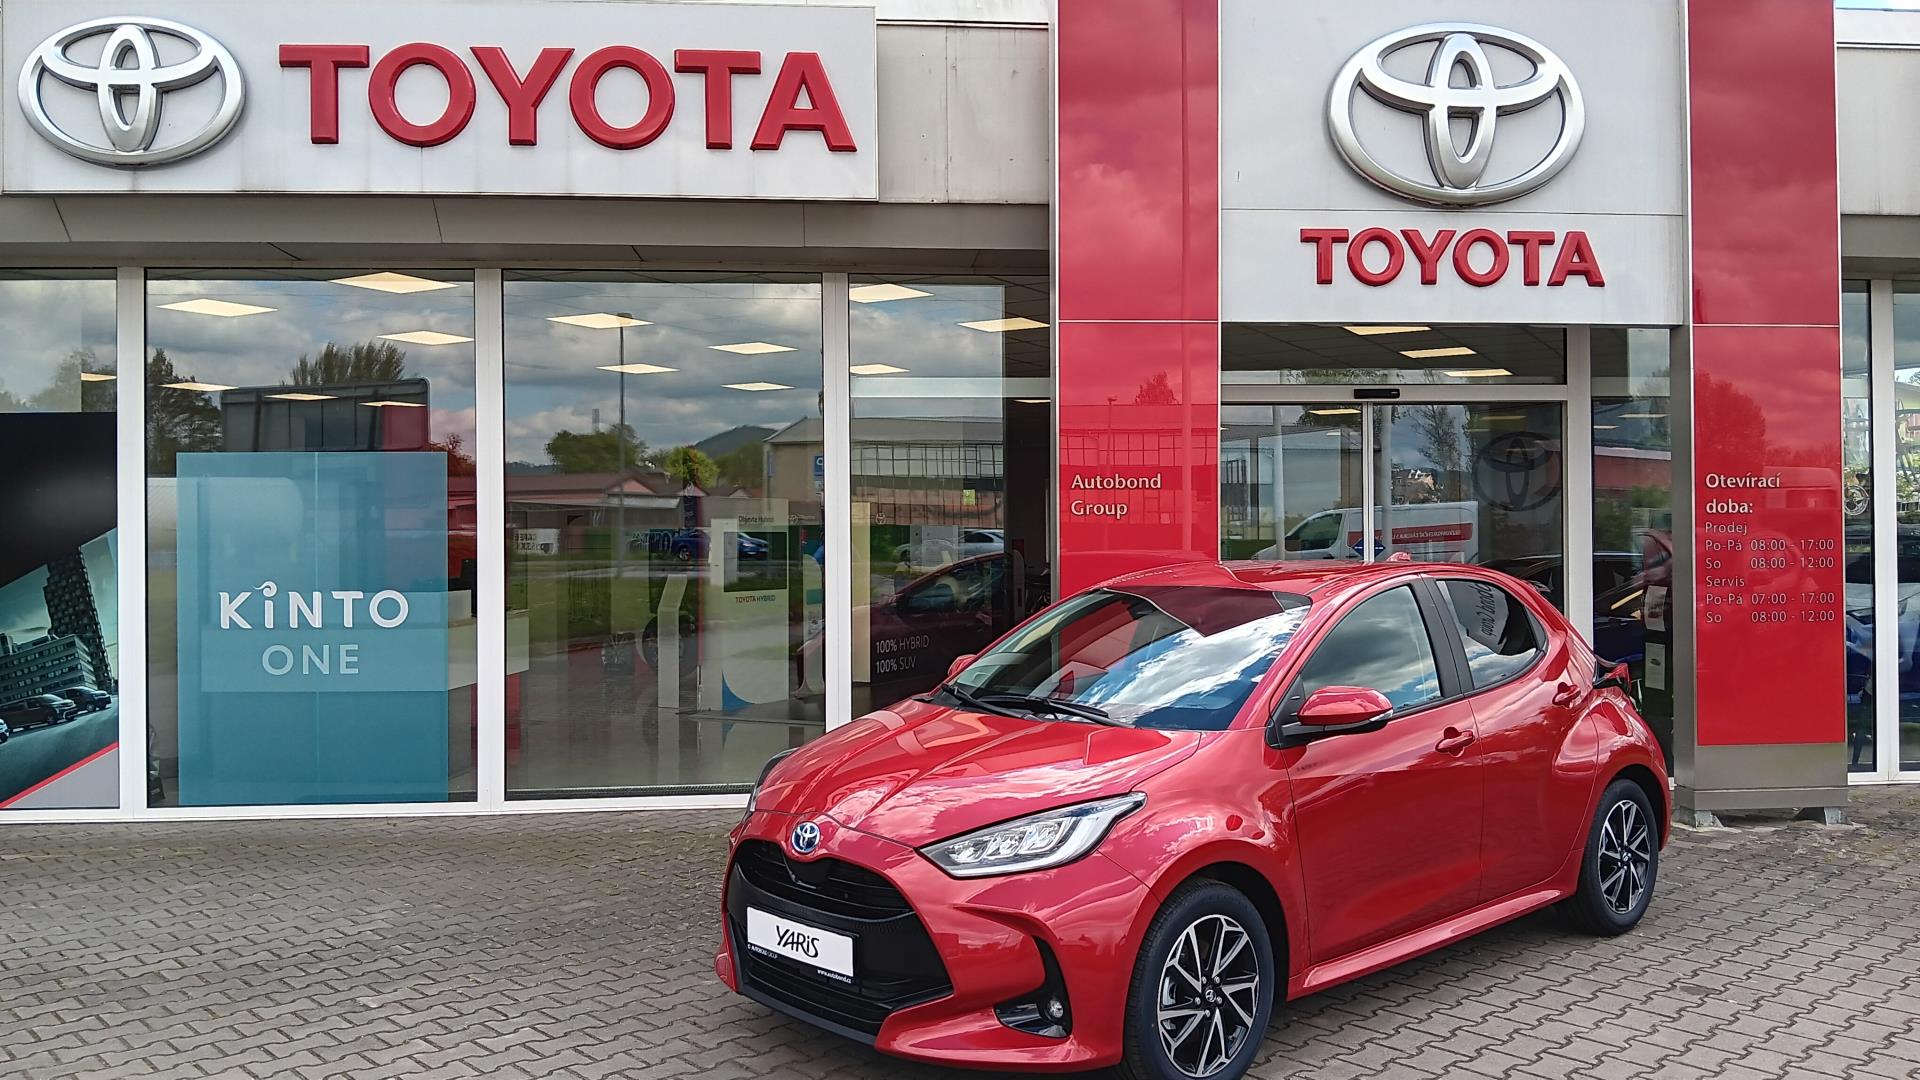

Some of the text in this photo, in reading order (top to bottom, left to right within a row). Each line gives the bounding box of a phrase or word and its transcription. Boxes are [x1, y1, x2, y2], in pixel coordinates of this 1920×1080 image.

[278, 42, 857, 152] TOYOTA
[1300, 227, 1606, 287] TOYOTA
[1071, 473, 1162, 489] Autobond
[1705, 472, 1781, 488] Otevírací
[1071, 500, 1128, 520] Group
[1705, 498, 1753, 514] doba:
[1705, 522, 1747, 535] Prodej
[1705, 539, 1742, 551] Po-Pá
[1750, 539, 1786, 550] 08:00
[1801, 539, 1834, 550] 17:00
[1705, 558, 1721, 569] So
[1750, 557, 1786, 568] 08:00
[1801, 557, 1834, 568] 12:00
[1705, 576, 1745, 587] Servis
[1706, 593, 1743, 605] Po-Pá
[1751, 593, 1787, 604] 07:00
[1802, 592, 1835, 603] 17:00
[1706, 612, 1722, 623] So
[1751, 611, 1787, 622] 08:00
[1802, 611, 1835, 622] 12:00
[876, 634, 930, 654] 100% HYBRID
[262, 644, 359, 675] ONE
[876, 656, 916, 673] 100% SUV
